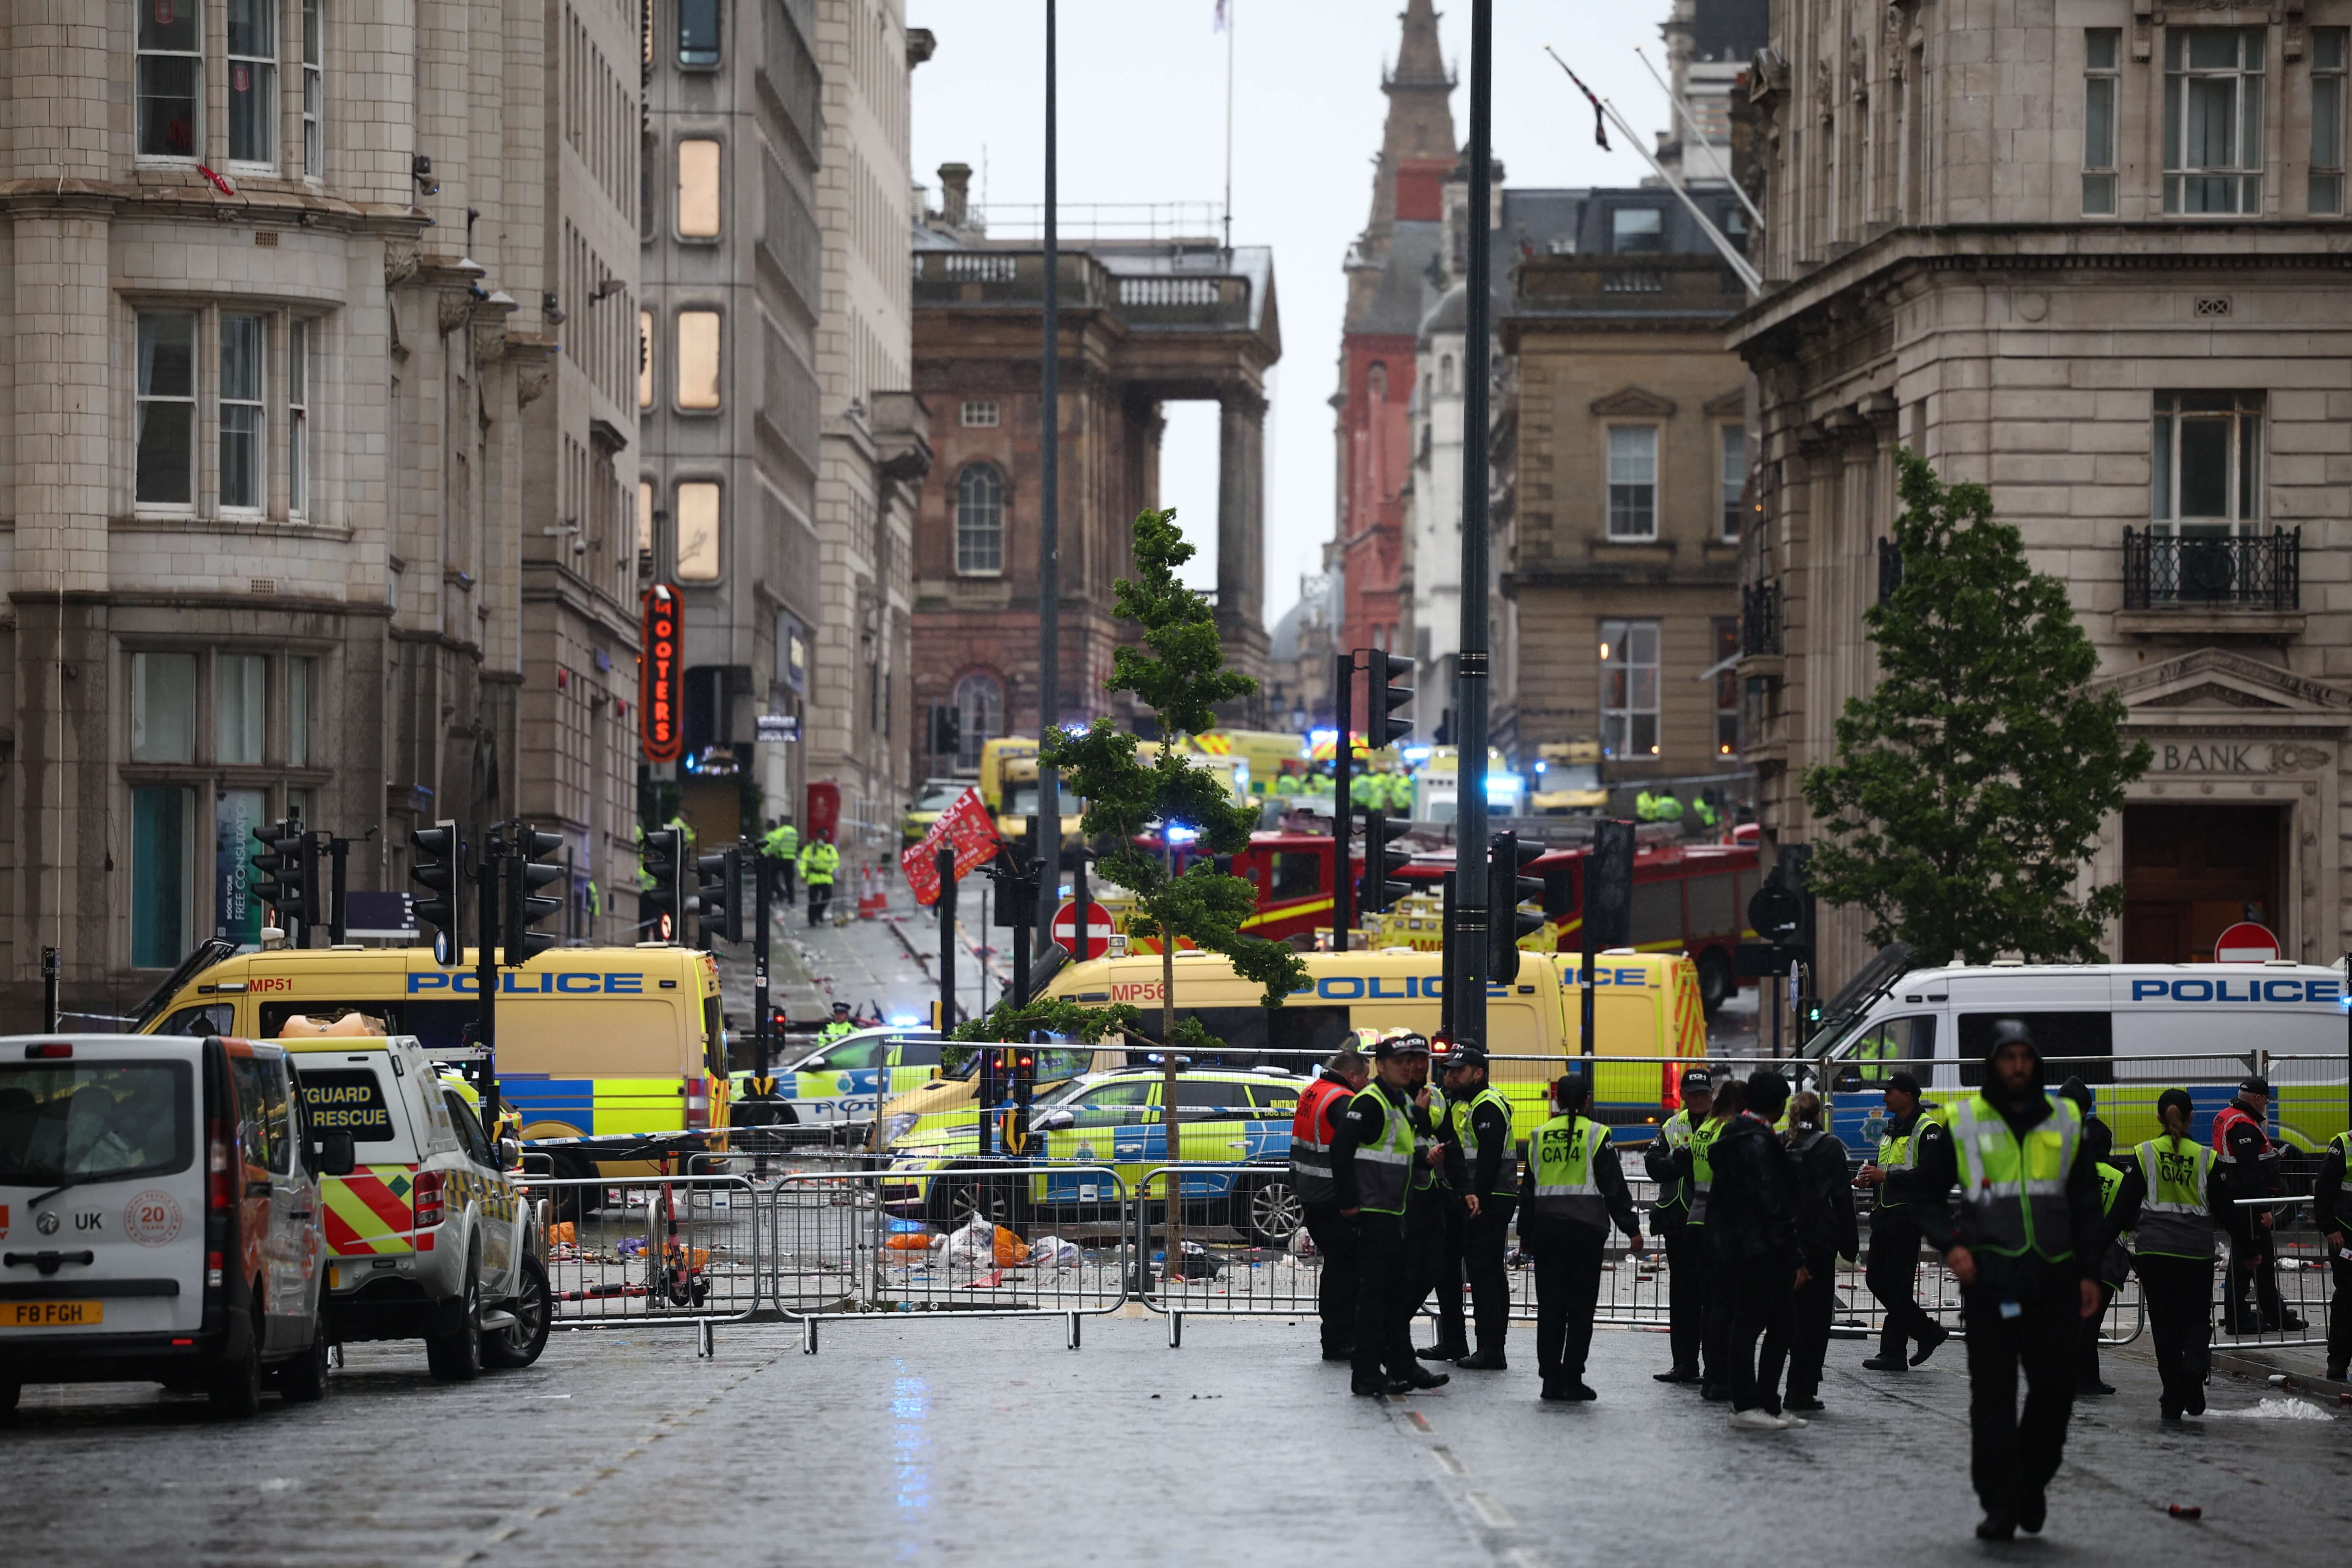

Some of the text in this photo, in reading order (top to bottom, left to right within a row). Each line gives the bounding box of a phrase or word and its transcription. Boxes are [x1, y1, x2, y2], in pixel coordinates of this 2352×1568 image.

[655, 600, 673, 742] HOOTERS
[2164, 745, 2252, 771] BANK
[235, 892, 245, 920] FREE
[407, 973, 643, 993] POLICE
[1564, 967, 1646, 985] ICE
[249, 978, 292, 992] MP51
[1112, 983, 1165, 1001] MP56
[1288, 976, 1508, 998] OLIC
[2132, 980, 2340, 1002] POLICE
[302, 1087, 371, 1103] GUARD
[313, 1109, 387, 1127] RESCUE
[1543, 1129, 1583, 1140] FGH
[1696, 1131, 1714, 1140] FGH
[1542, 1146, 1580, 1163] CA74
[2160, 1152, 2194, 1166] FGH
[75, 1213, 102, 1230] UK
[141, 1206, 165, 1223] 20
[17, 1305, 83, 1322] F8 FGH
